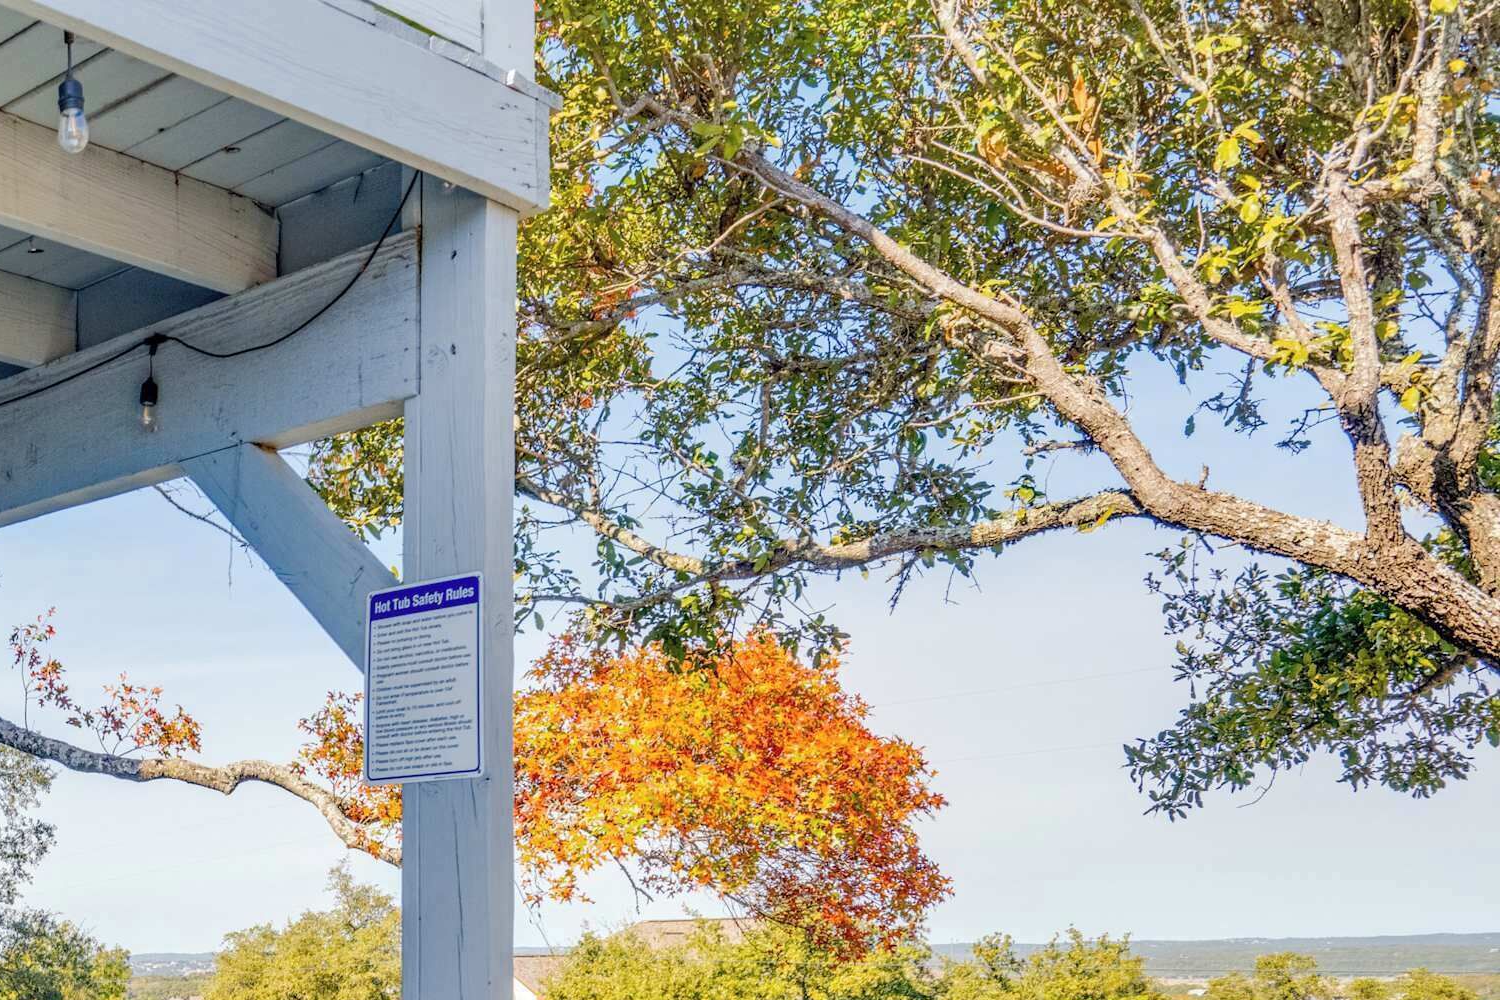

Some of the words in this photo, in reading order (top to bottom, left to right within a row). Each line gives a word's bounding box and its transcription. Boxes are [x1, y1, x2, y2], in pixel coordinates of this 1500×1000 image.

[374, 599, 390, 614] Hot
[392, 596, 410, 611] Tub
[412, 591, 443, 607] Safety
[445, 586, 474, 601] Rules
